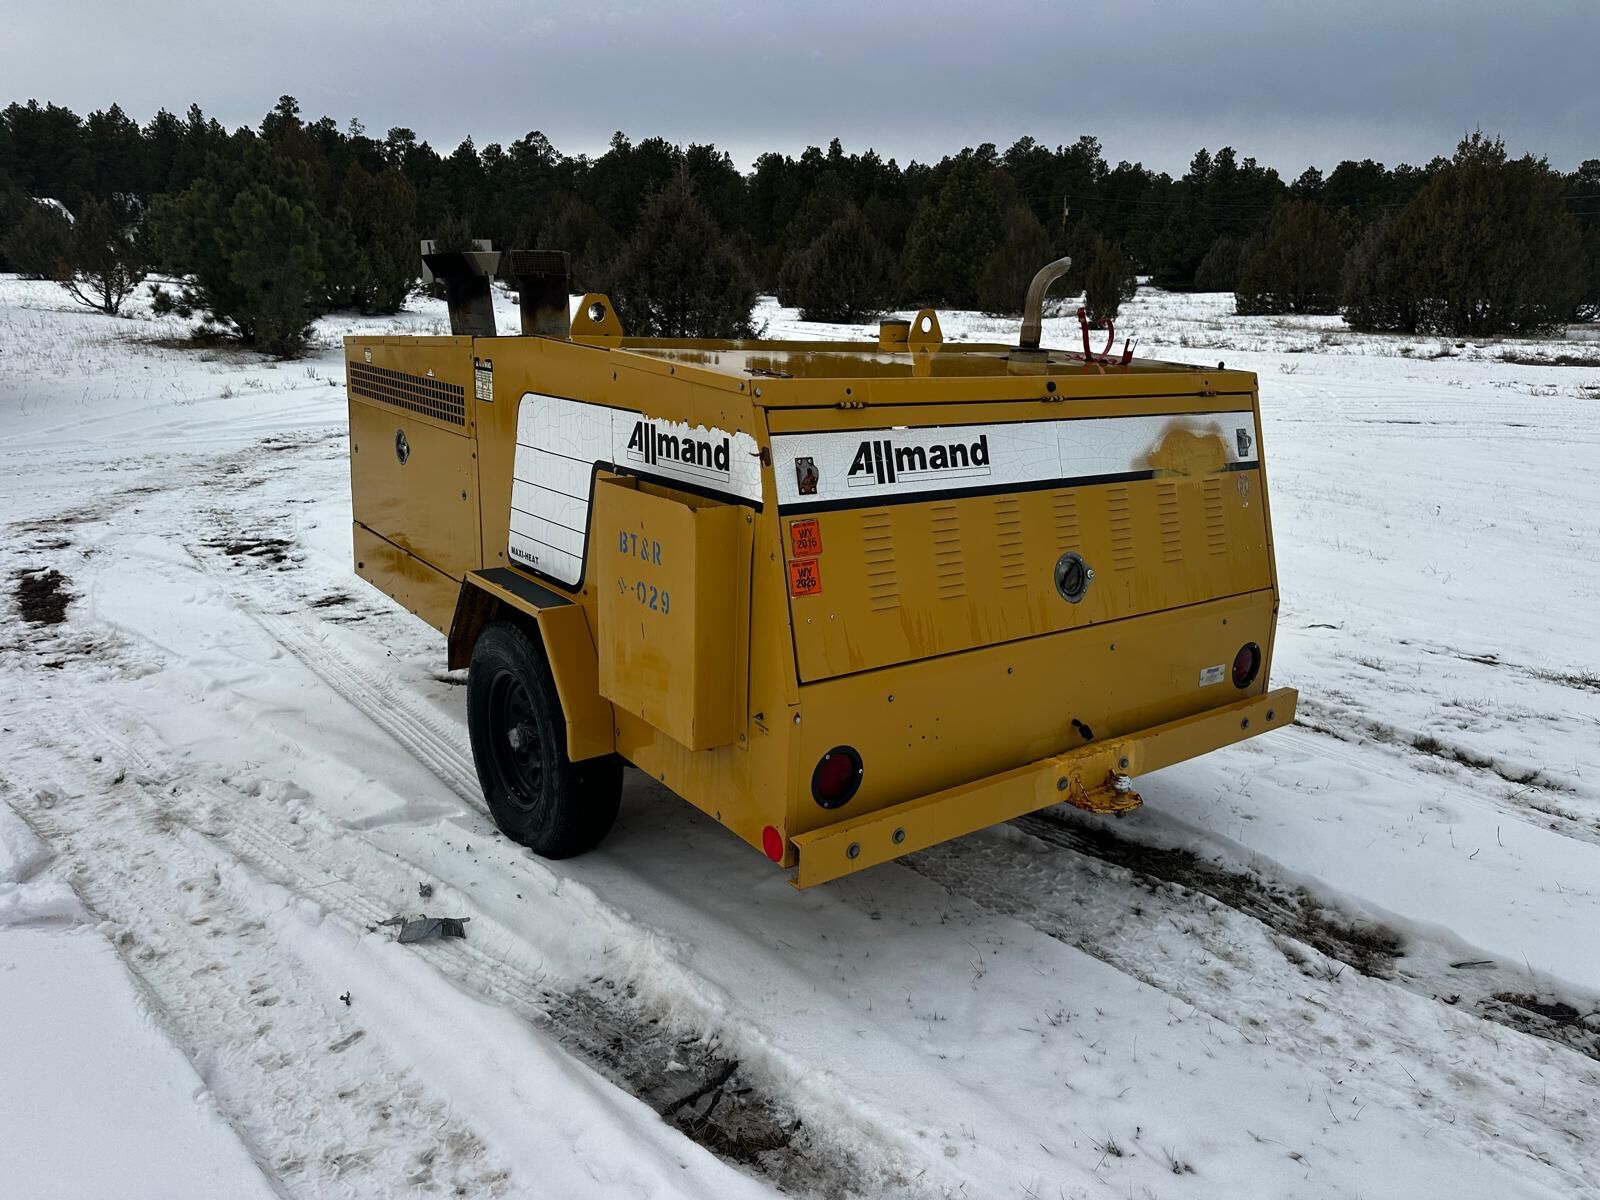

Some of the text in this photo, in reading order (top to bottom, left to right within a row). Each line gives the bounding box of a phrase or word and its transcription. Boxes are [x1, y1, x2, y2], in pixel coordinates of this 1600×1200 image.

[627, 421, 731, 472] Allmand
[847, 434, 991, 485] Allmand
[798, 528, 813, 539] WY
[511, 546, 539, 565] MAXI-HEAT
[619, 530, 662, 566] BT&R
[797, 566, 812, 577] WY
